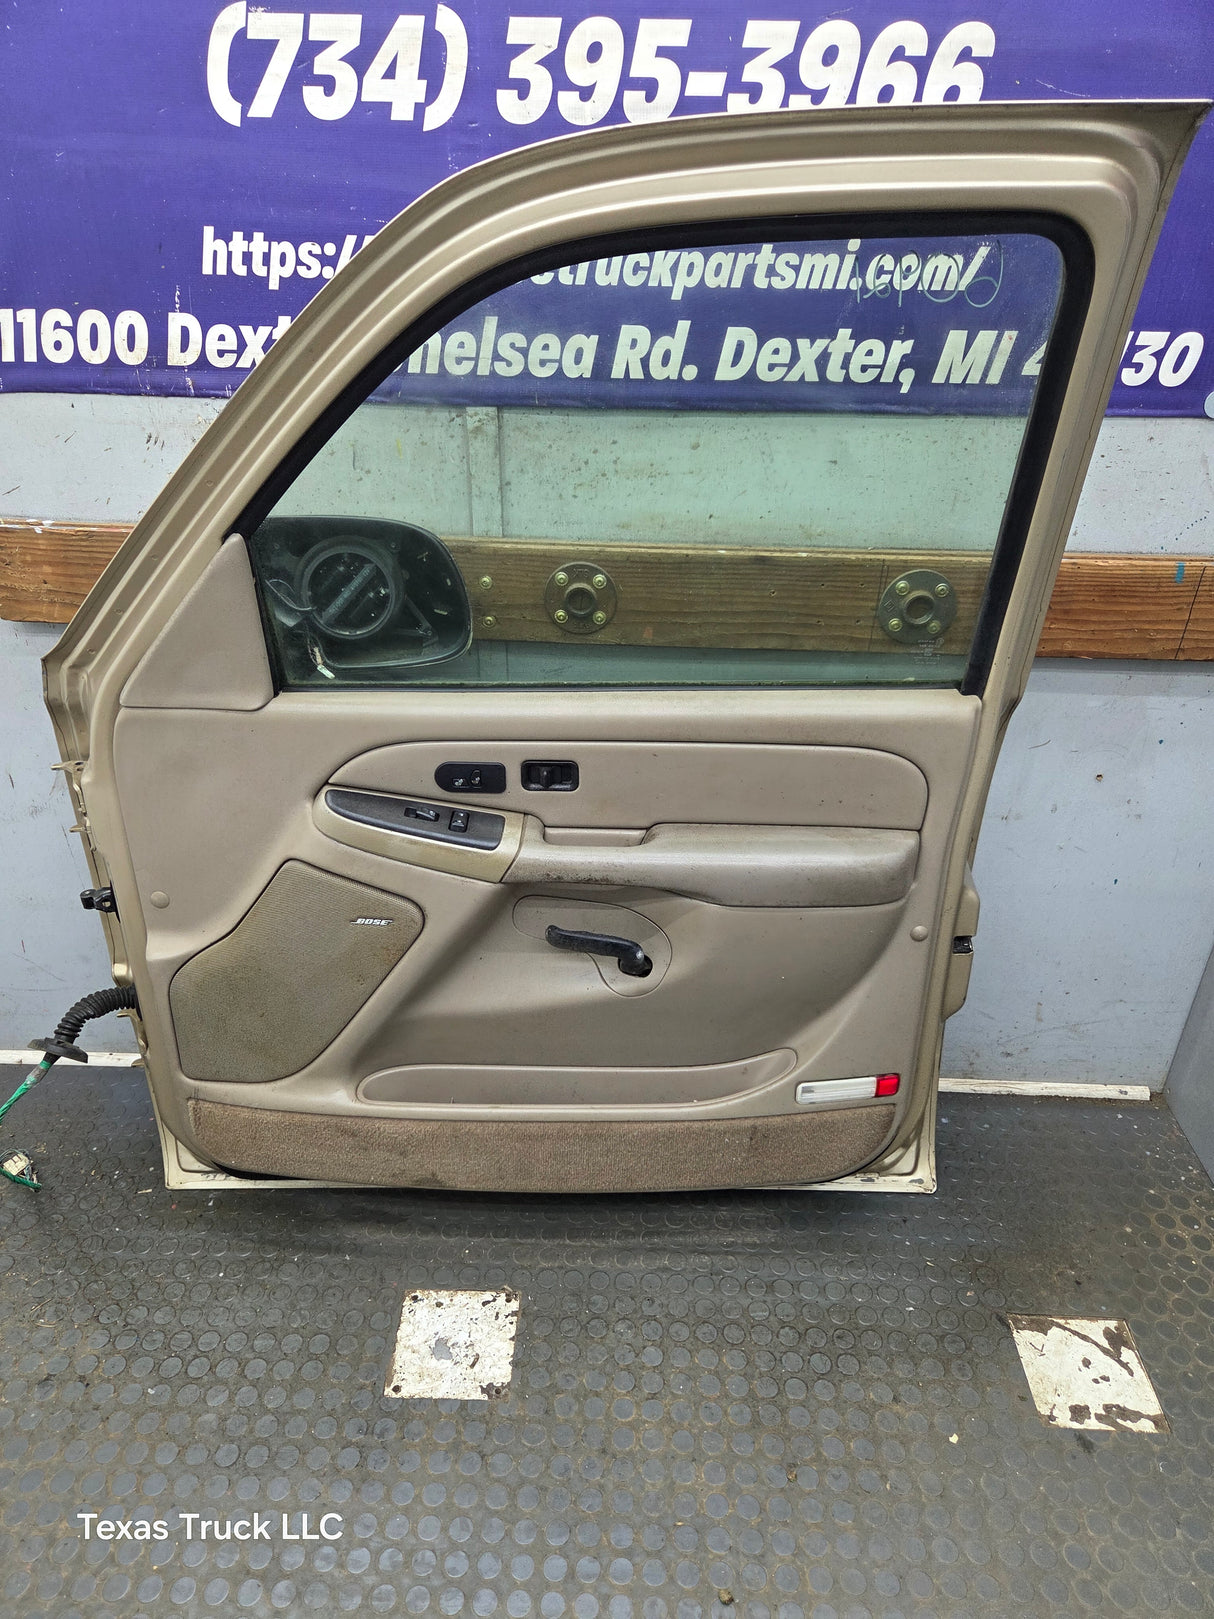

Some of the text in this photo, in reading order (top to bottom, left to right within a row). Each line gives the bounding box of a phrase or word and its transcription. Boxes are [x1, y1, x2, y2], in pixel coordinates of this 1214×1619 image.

[206, 0, 996, 132] (734) 395-3966
[0, 308, 149, 366] 11600
[394, 316, 598, 378] helsea
[610, 320, 698, 381] Rd.
[714, 326, 916, 394] Dexter,
[932, 330, 1019, 384] MI
[350, 917, 394, 926] BOSE
